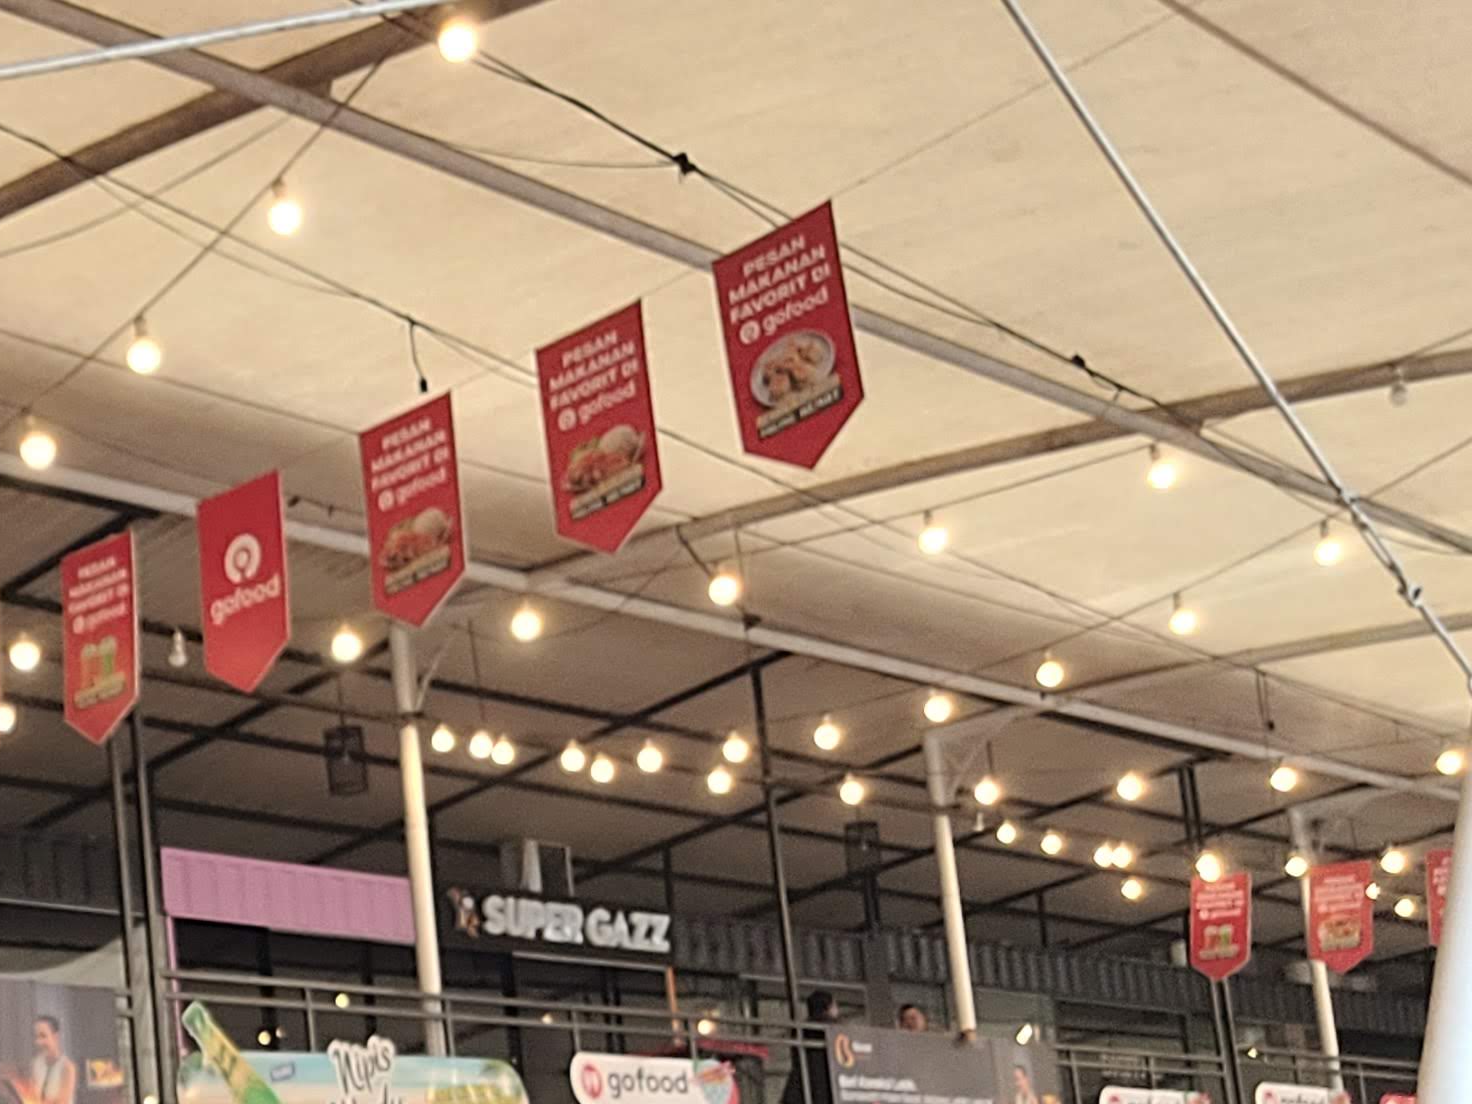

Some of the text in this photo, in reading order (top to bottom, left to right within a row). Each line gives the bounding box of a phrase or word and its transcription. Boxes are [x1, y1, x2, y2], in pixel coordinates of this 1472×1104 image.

[727, 244, 826, 307] MAKANAN
[742, 234, 806, 278] PESAN
[729, 262, 831, 325] FAVORIT DI
[762, 285, 830, 337] gofood
[548, 339, 636, 392] MAKANAN
[561, 329, 618, 369] PESAN
[548, 366, 618, 412] FAVORIT
[578, 378, 636, 425] gofood
[210, 571, 281, 627] gofood
[482, 894, 671, 954] SUPER GAZZ
[332, 1044, 392, 1095] Nipis
[607, 1066, 689, 1099] gofood
